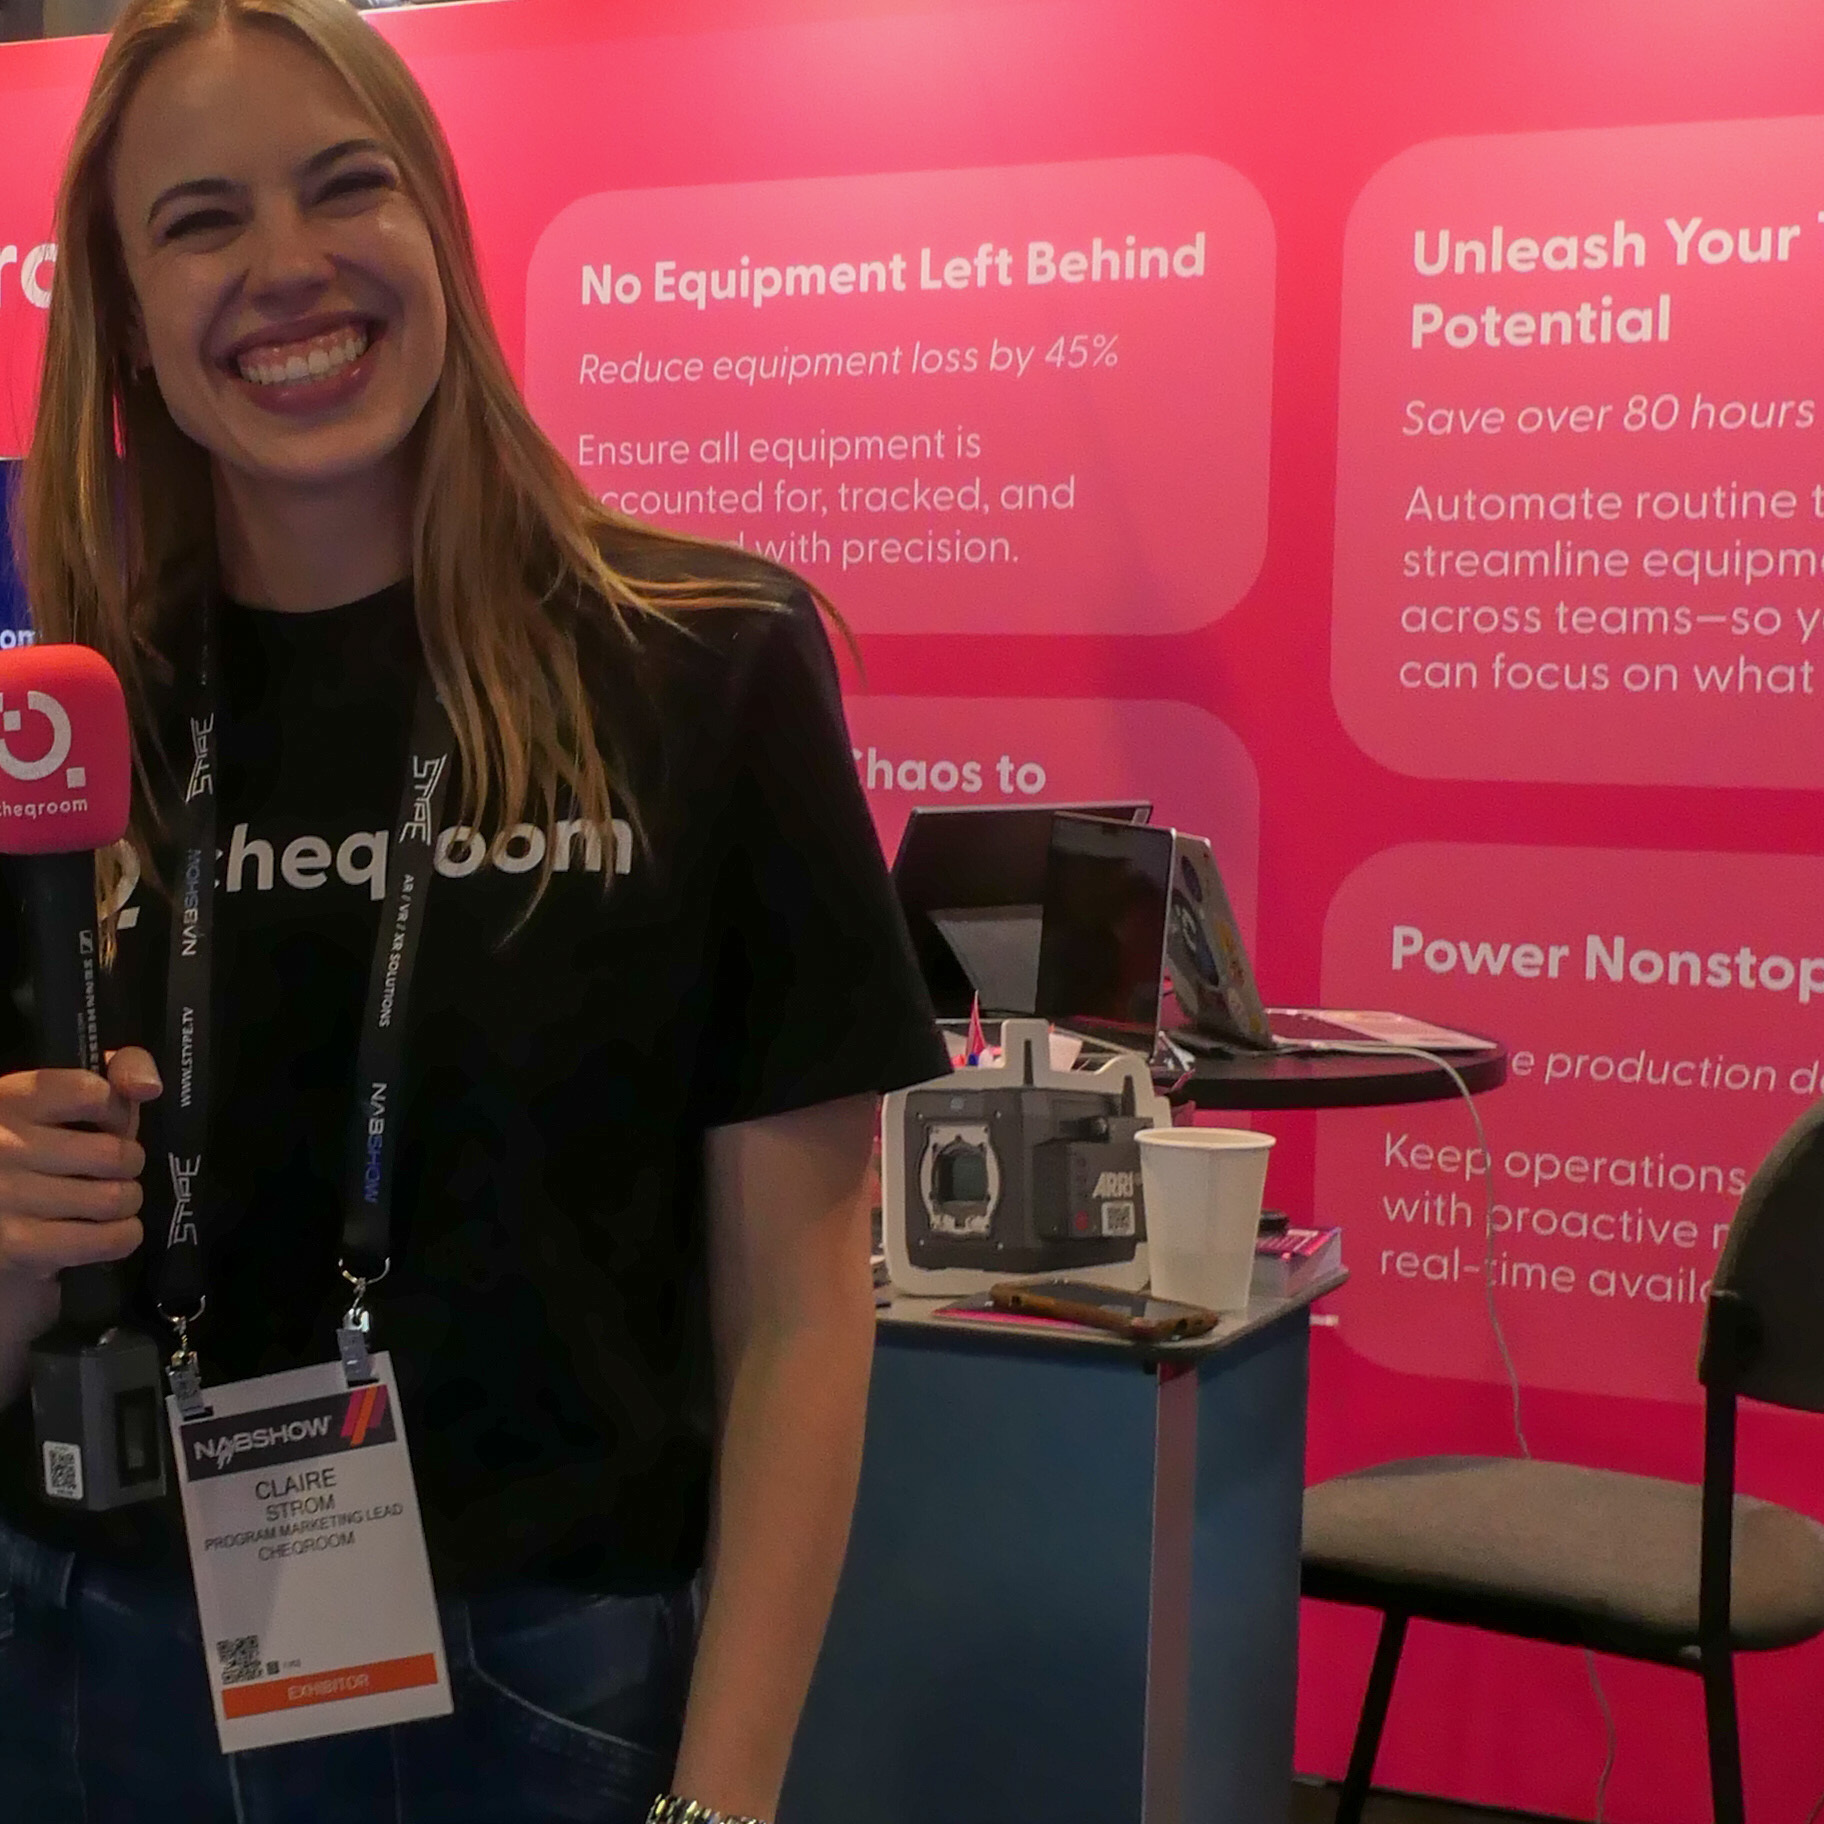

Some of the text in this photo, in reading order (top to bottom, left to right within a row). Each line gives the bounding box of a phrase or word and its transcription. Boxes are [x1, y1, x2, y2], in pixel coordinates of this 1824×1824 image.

[1413, 217, 1801, 276] Unleash Your
[581, 231, 1206, 310] No Equipment Left Behind
[1411, 293, 1672, 349] Potential
[580, 334, 1119, 386] Reduce equipment loss by 45%
[1402, 393, 1815, 436] Save over 80 hours
[578, 424, 982, 469] Ensure all equipment is
[600, 474, 1075, 517] ccounted for, tracked, and
[1405, 485, 1623, 522] Automate
[1637, 481, 1797, 520] routine
[755, 530, 831, 564] with
[842, 529, 1018, 571] precision.
[1402, 539, 1824, 586] streamline equipm
[1401, 604, 1542, 634] across
[1399, 652, 1814, 693] can focus on what
[852, 747, 1046, 795] haos to
[1391, 925, 1824, 1004] Power Nonstop
[1544, 1050, 1778, 1092] production
[1384, 1132, 1747, 1196] Keep operations
[1383, 1191, 1473, 1228] with
[1486, 1203, 1698, 1245] proactive
[255, 1467, 337, 1500] CLAIRE
[266, 1494, 336, 1522] STROM
